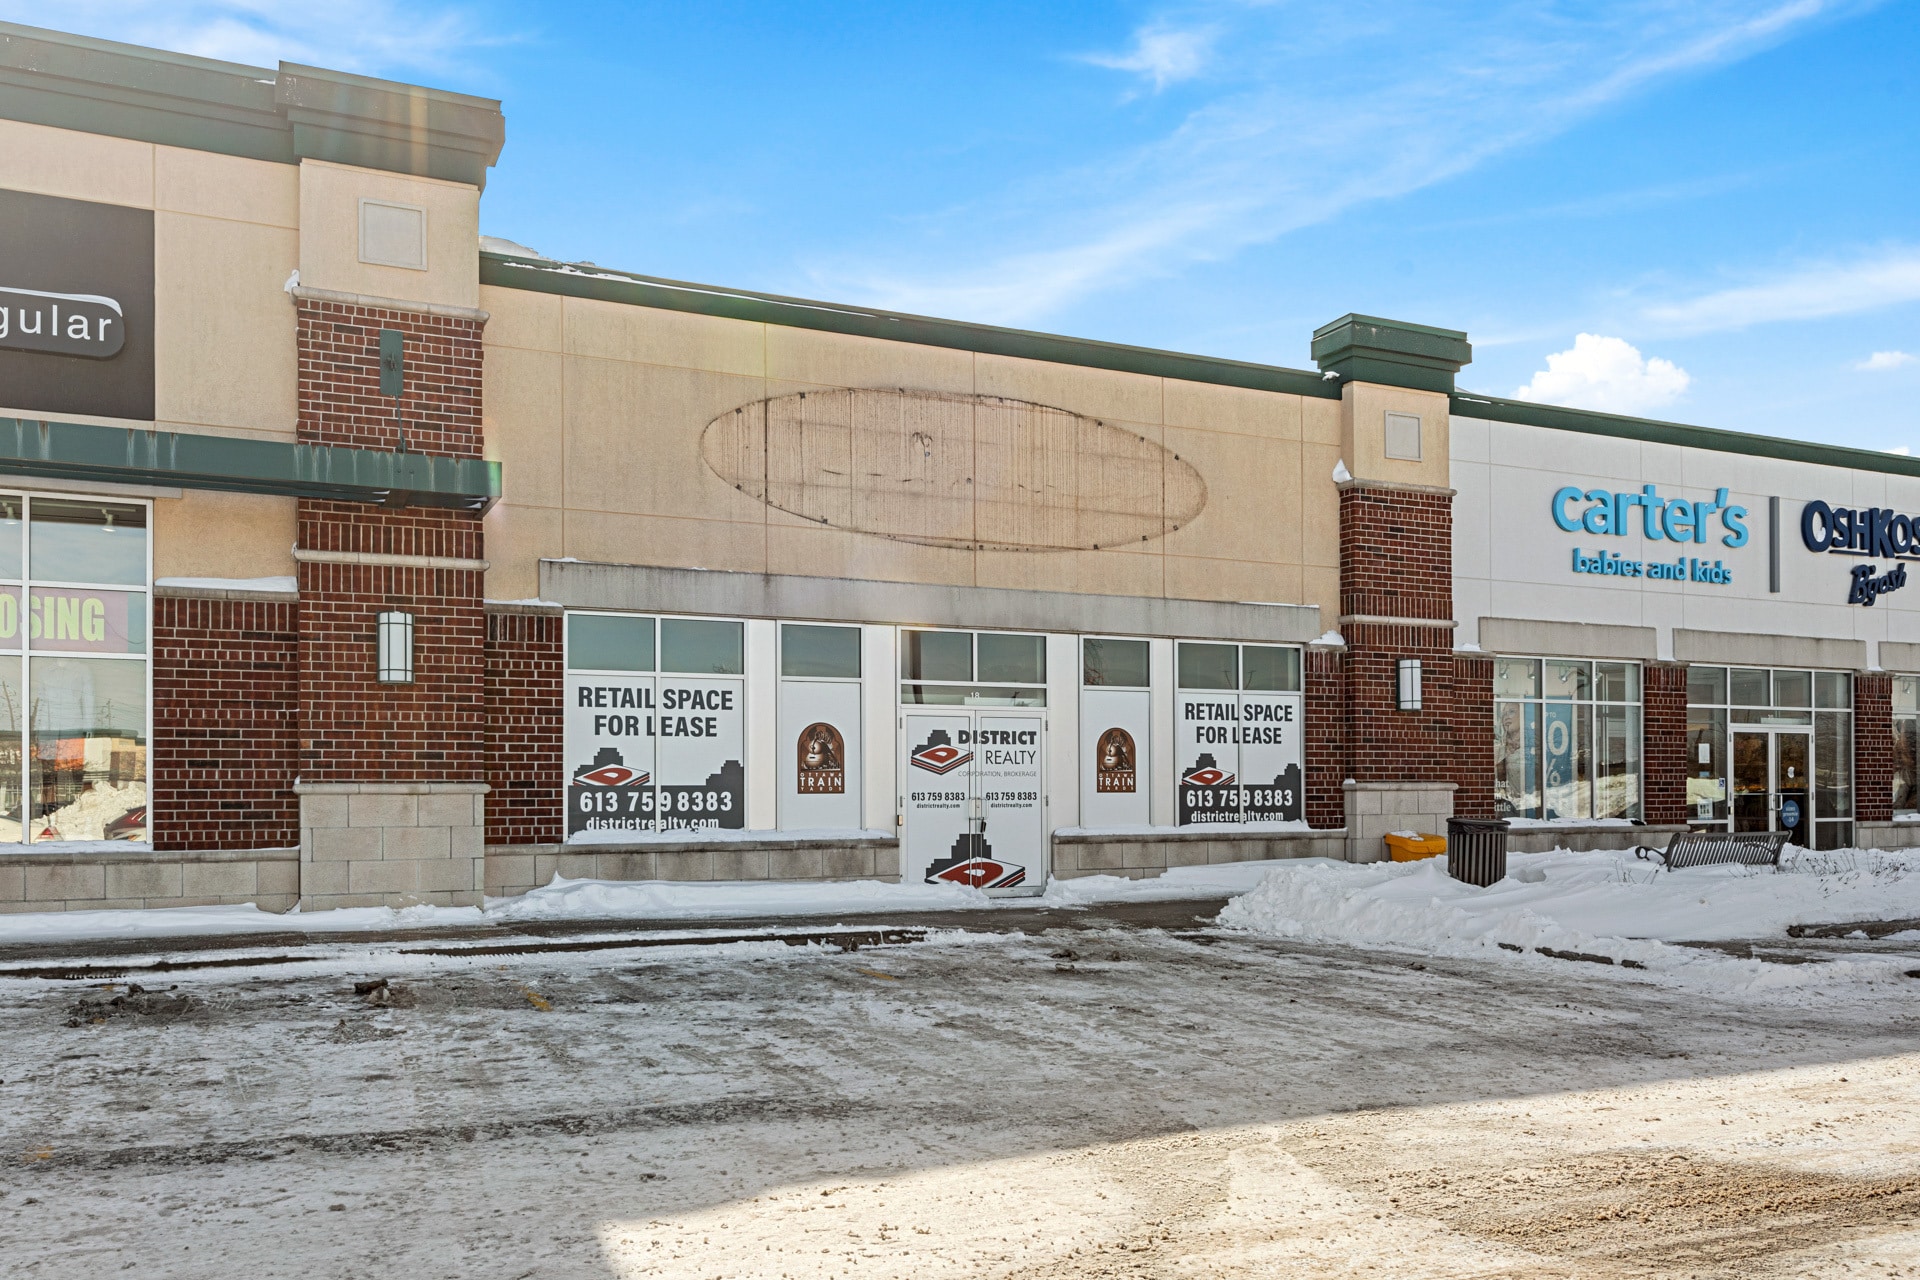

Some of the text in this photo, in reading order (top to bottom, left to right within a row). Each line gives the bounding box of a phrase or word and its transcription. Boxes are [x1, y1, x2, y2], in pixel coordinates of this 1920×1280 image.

[1552, 485, 1750, 548] carter's
[1572, 548, 1733, 585] babies and kids
[578, 687, 734, 711] RETAIL SPACE
[1185, 703, 1293, 722] RETAIL SPACE
[594, 715, 718, 737] FOR LEASE
[958, 730, 1037, 745] DISTRICT
[1196, 726, 1282, 745] FOR LEASE
[985, 750, 1036, 765] REALTY
[800, 777, 842, 786] TRAIN
[1098, 778, 1134, 786] TRAIN
[579, 791, 733, 812] 613 759 8383
[911, 792, 965, 801] 613 759 8383
[986, 791, 1037, 801] 613 759 8383
[1186, 790, 1293, 807] 613 759 8383
[586, 816, 719, 831] districtrealty.com
